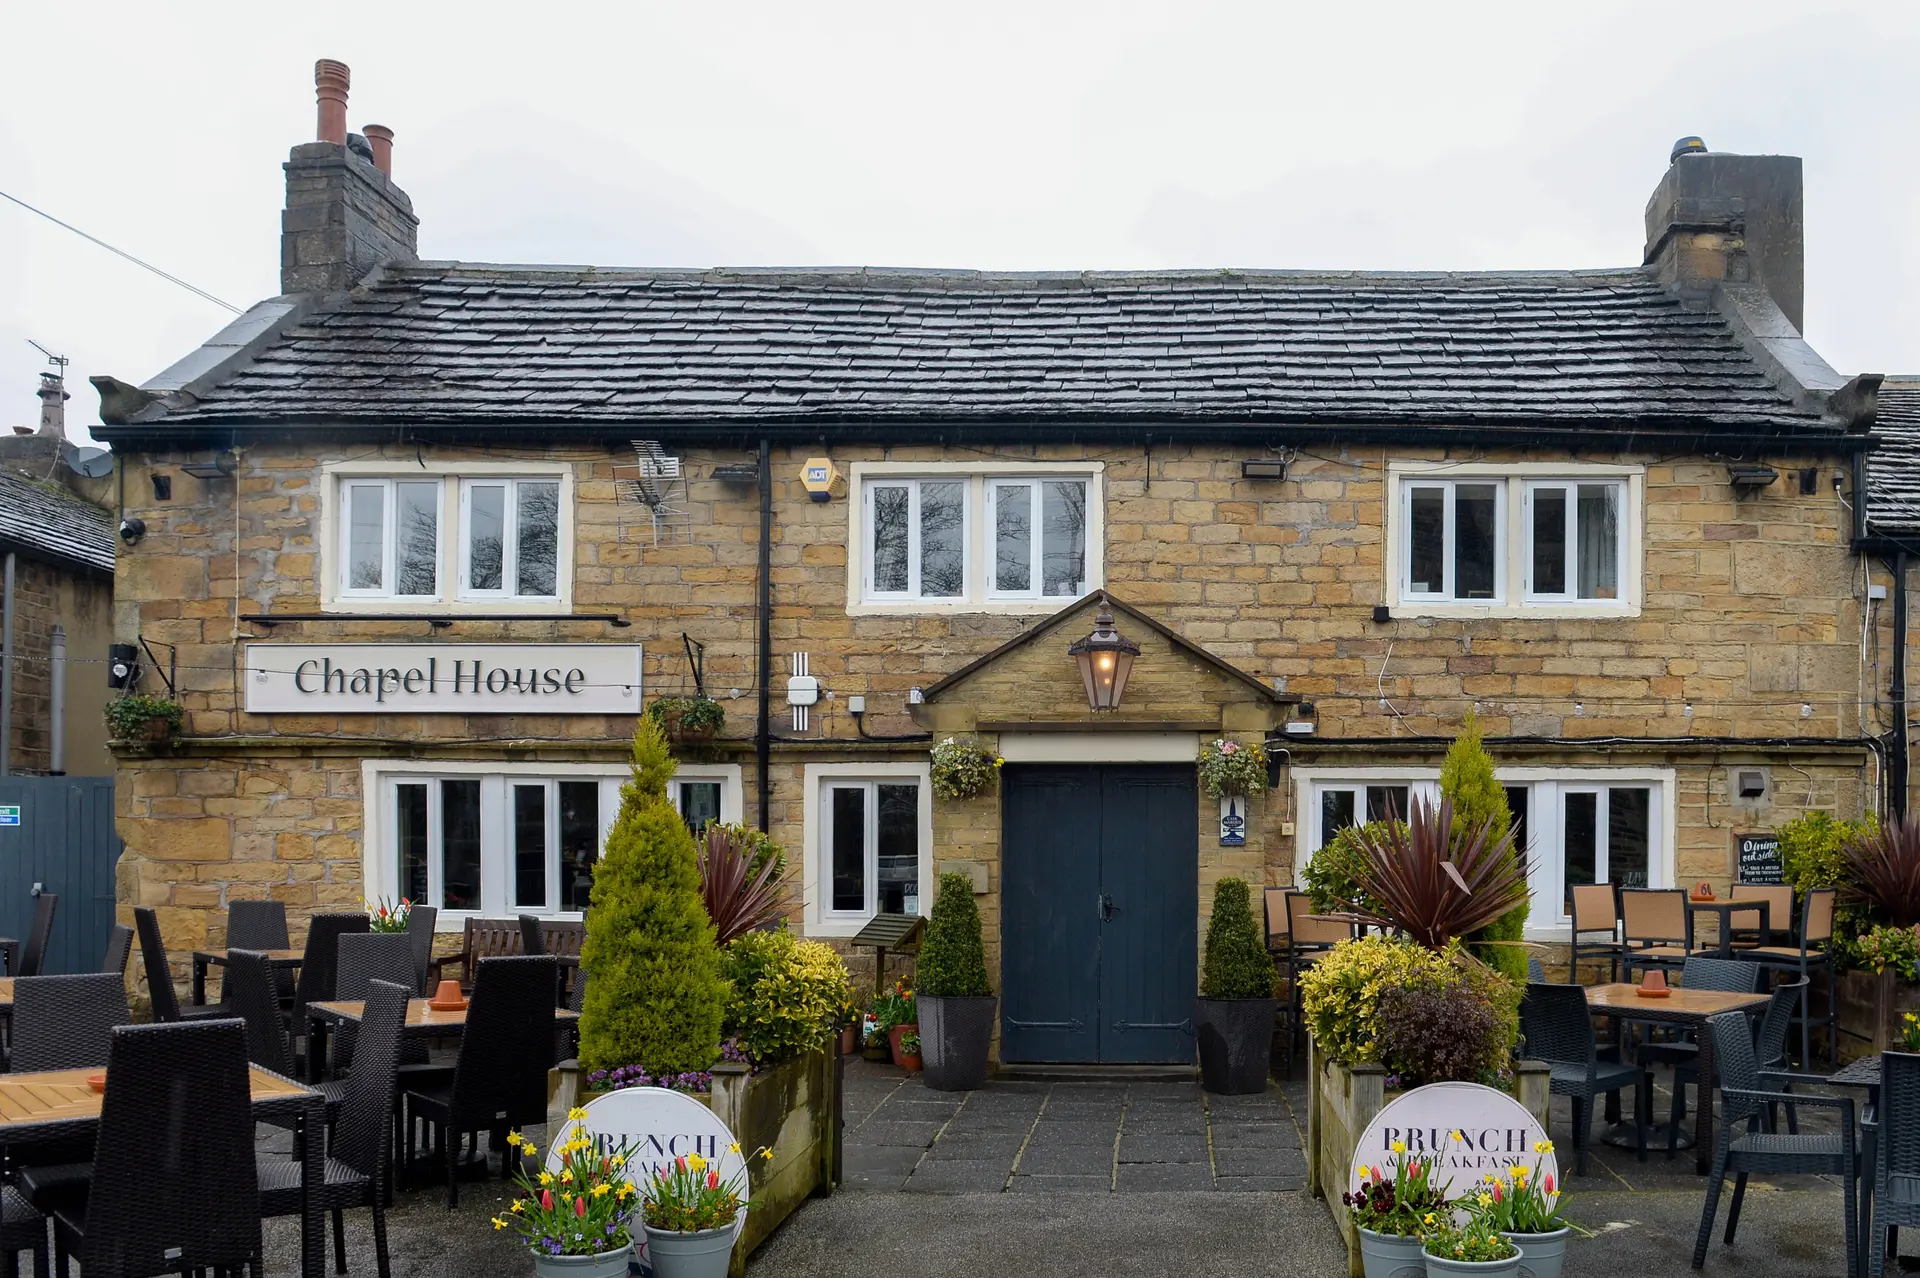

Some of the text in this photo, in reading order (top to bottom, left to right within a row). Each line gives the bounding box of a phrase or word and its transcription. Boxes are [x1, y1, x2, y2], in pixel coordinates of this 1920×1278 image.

[809, 470, 826, 480] ADT
[294, 656, 586, 703] Chapel House
[584, 1132, 718, 1159] RUNCH
[1382, 1127, 1528, 1152] BRUNCH
